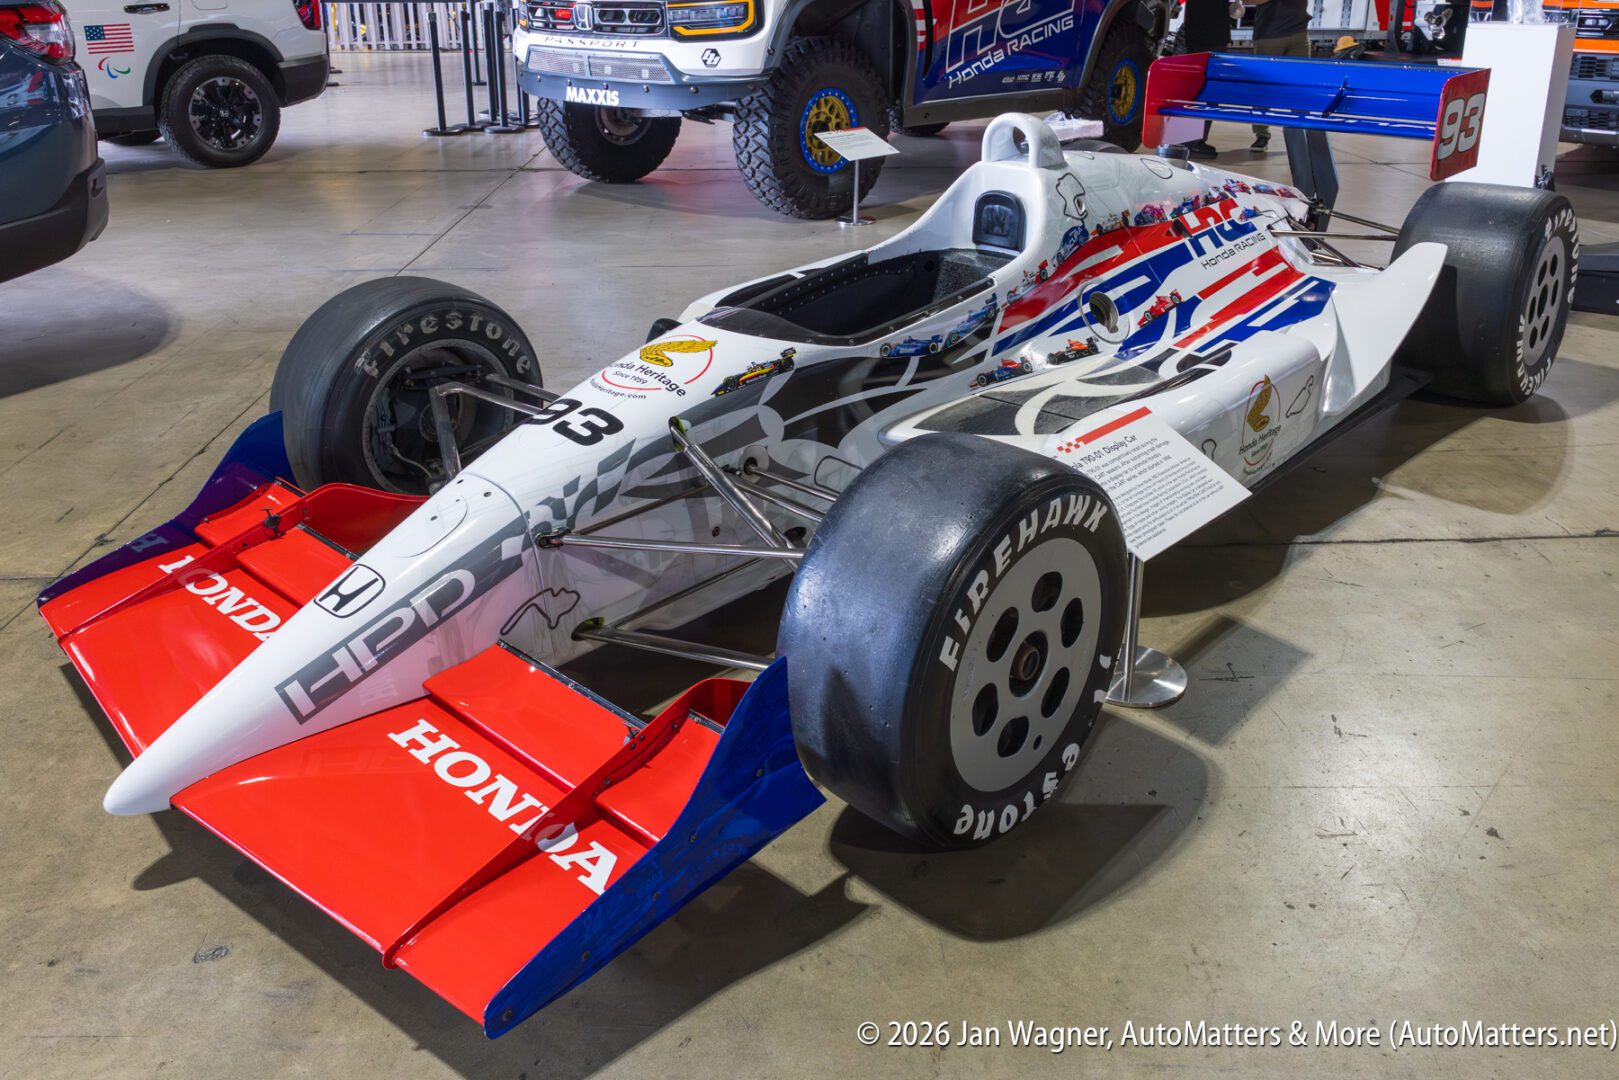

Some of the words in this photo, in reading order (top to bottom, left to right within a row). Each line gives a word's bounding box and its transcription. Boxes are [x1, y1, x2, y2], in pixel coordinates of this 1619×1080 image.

[544, 36, 640, 49] PASSPORT
[948, 48, 1004, 89] Honda
[1007, 15, 1074, 56] RACING
[566, 86, 620, 107] MAXXIS
[1437, 92, 1487, 161] 93
[1201, 248, 1236, 269] Honda
[1234, 232, 1266, 253] RACING
[354, 312, 531, 378] Firestone
[635, 364, 687, 397] Heritage
[525, 398, 625, 446] 93
[1079, 450, 1105, 465] T90-01
[1102, 439, 1128, 455] Display
[1122, 433, 1138, 443] Car
[939, 494, 1108, 672] FIREHAWK
[284, 568, 475, 718] HPD
